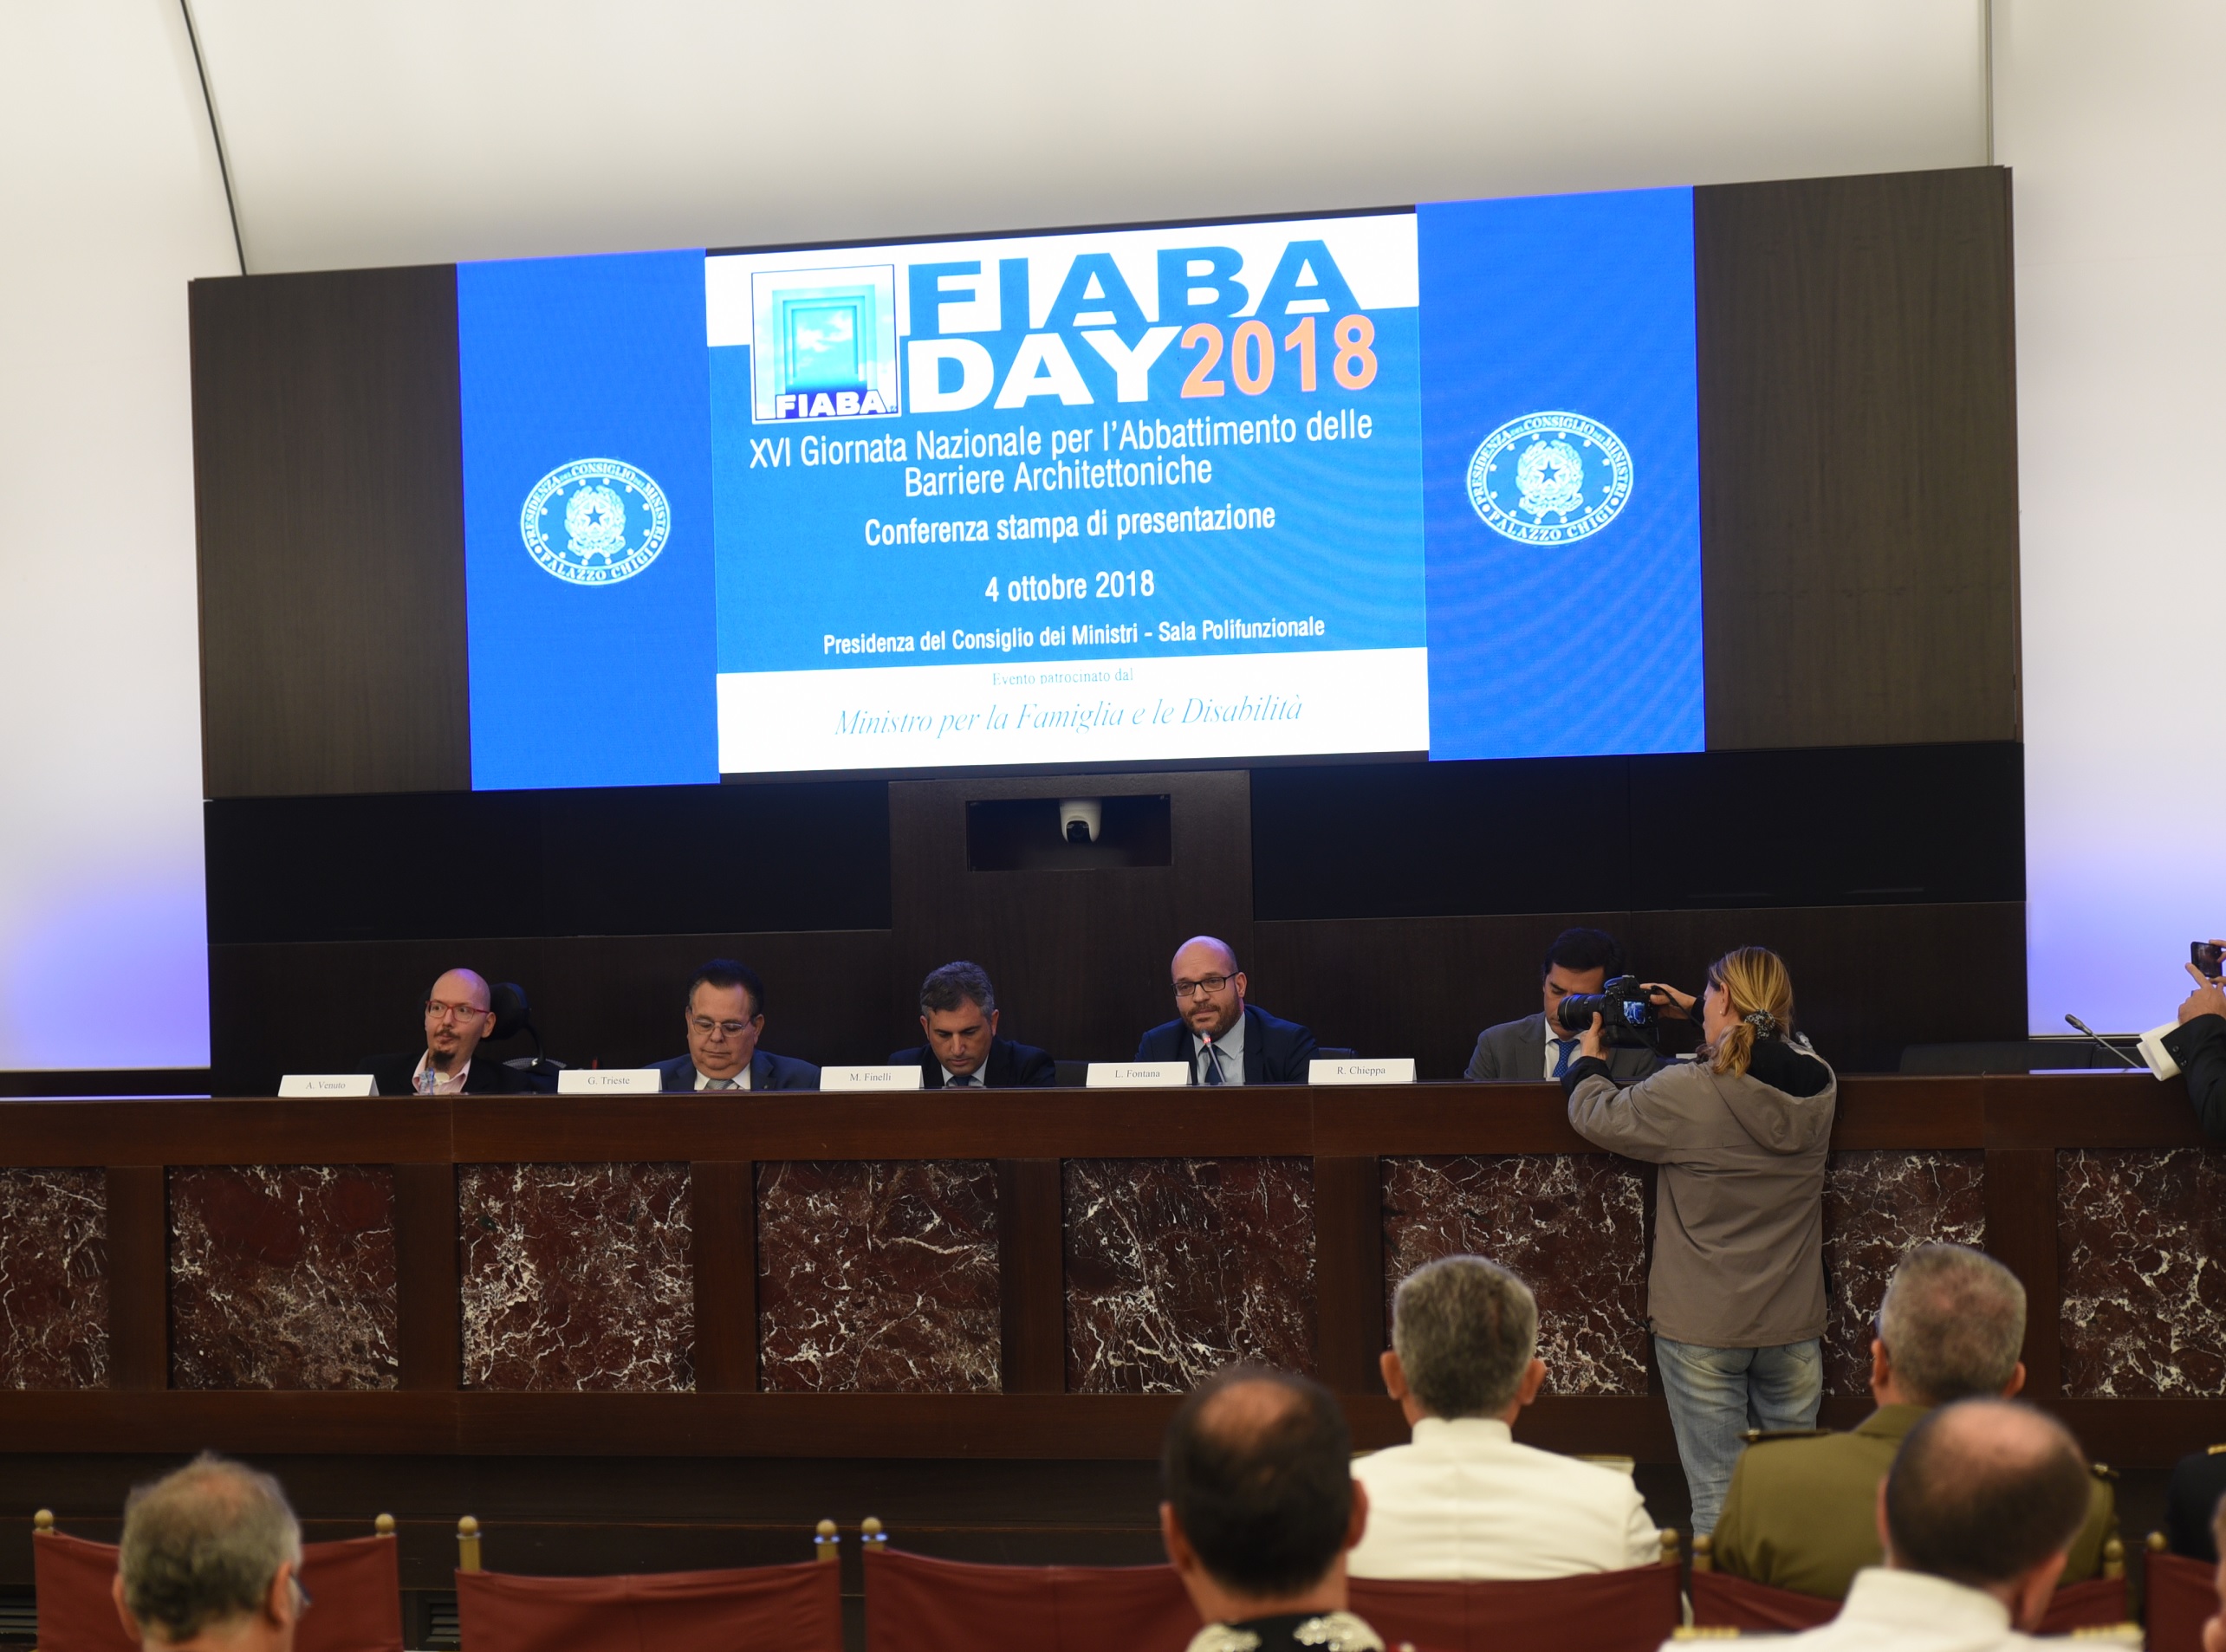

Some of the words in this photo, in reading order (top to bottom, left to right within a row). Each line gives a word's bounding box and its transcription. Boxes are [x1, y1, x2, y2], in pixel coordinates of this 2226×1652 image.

[909, 240, 1362, 335] FIABA
[908, 326, 1182, 413] DAY
[1180, 314, 1378, 398] 2018
[776, 390, 886, 419] FIABA
[750, 437, 790, 469] XVI
[801, 433, 907, 467] Giornata
[916, 425, 1042, 461] Nazionale
[1051, 426, 1093, 460] per
[1307, 408, 1373, 442] delle
[905, 464, 1005, 497] Barriere
[1013, 454, 1212, 492] Architettoniche
[1472, 430, 1512, 505] PRESIDENZA
[1523, 416, 1595, 437] CONSIGLIO
[1602, 437, 1628, 499] MINISTRI
[525, 476, 561, 547] PRESIDENZA
[571, 463, 635, 482] CONSIGLIO
[643, 483, 666, 542] MINISTRI
[1489, 511, 1561, 541] PALAZZO
[1567, 505, 1614, 538] CHIGI
[865, 517, 990, 547] Conferenza
[996, 515, 1079, 543] stampa
[1087, 509, 1107, 536] di
[1117, 503, 1275, 541] presentazione
[540, 552, 606, 581] PALAZZO
[611, 547, 654, 579] CHIGI
[985, 576, 999, 602] 4
[1008, 573, 1087, 602] ottobre
[1095, 569, 1155, 599] 2018
[823, 633, 915, 655] Presidenza
[919, 631, 946, 651] del
[951, 627, 1035, 652] Consiglio
[1039, 625, 1066, 646] dei
[1071, 623, 1138, 645] Ministri
[1158, 620, 1197, 642] Sala
[1202, 616, 1325, 640] Polifunzionale
[993, 672, 1035, 685] Evento
[1040, 669, 1111, 684] patrocinato
[1114, 667, 1133, 681] dal
[834, 709, 932, 735] Ministro
[936, 713, 981, 739] per
[986, 703, 1009, 729] la
[1016, 701, 1125, 734] Famiglia
[1132, 709, 1145, 725] e
[1152, 698, 1174, 724] le
[1181, 694, 1303, 724] Disabilità
[306, 1081, 315, 1090] A.
[318, 1081, 346, 1090] Venuto
[587, 1076, 598, 1085] G.
[601, 1076, 630, 1085] Trieste
[864, 1072, 892, 1081] Finelli
[1126, 1069, 1160, 1078] Fontana
[1349, 1066, 1386, 1076] Chieppa
